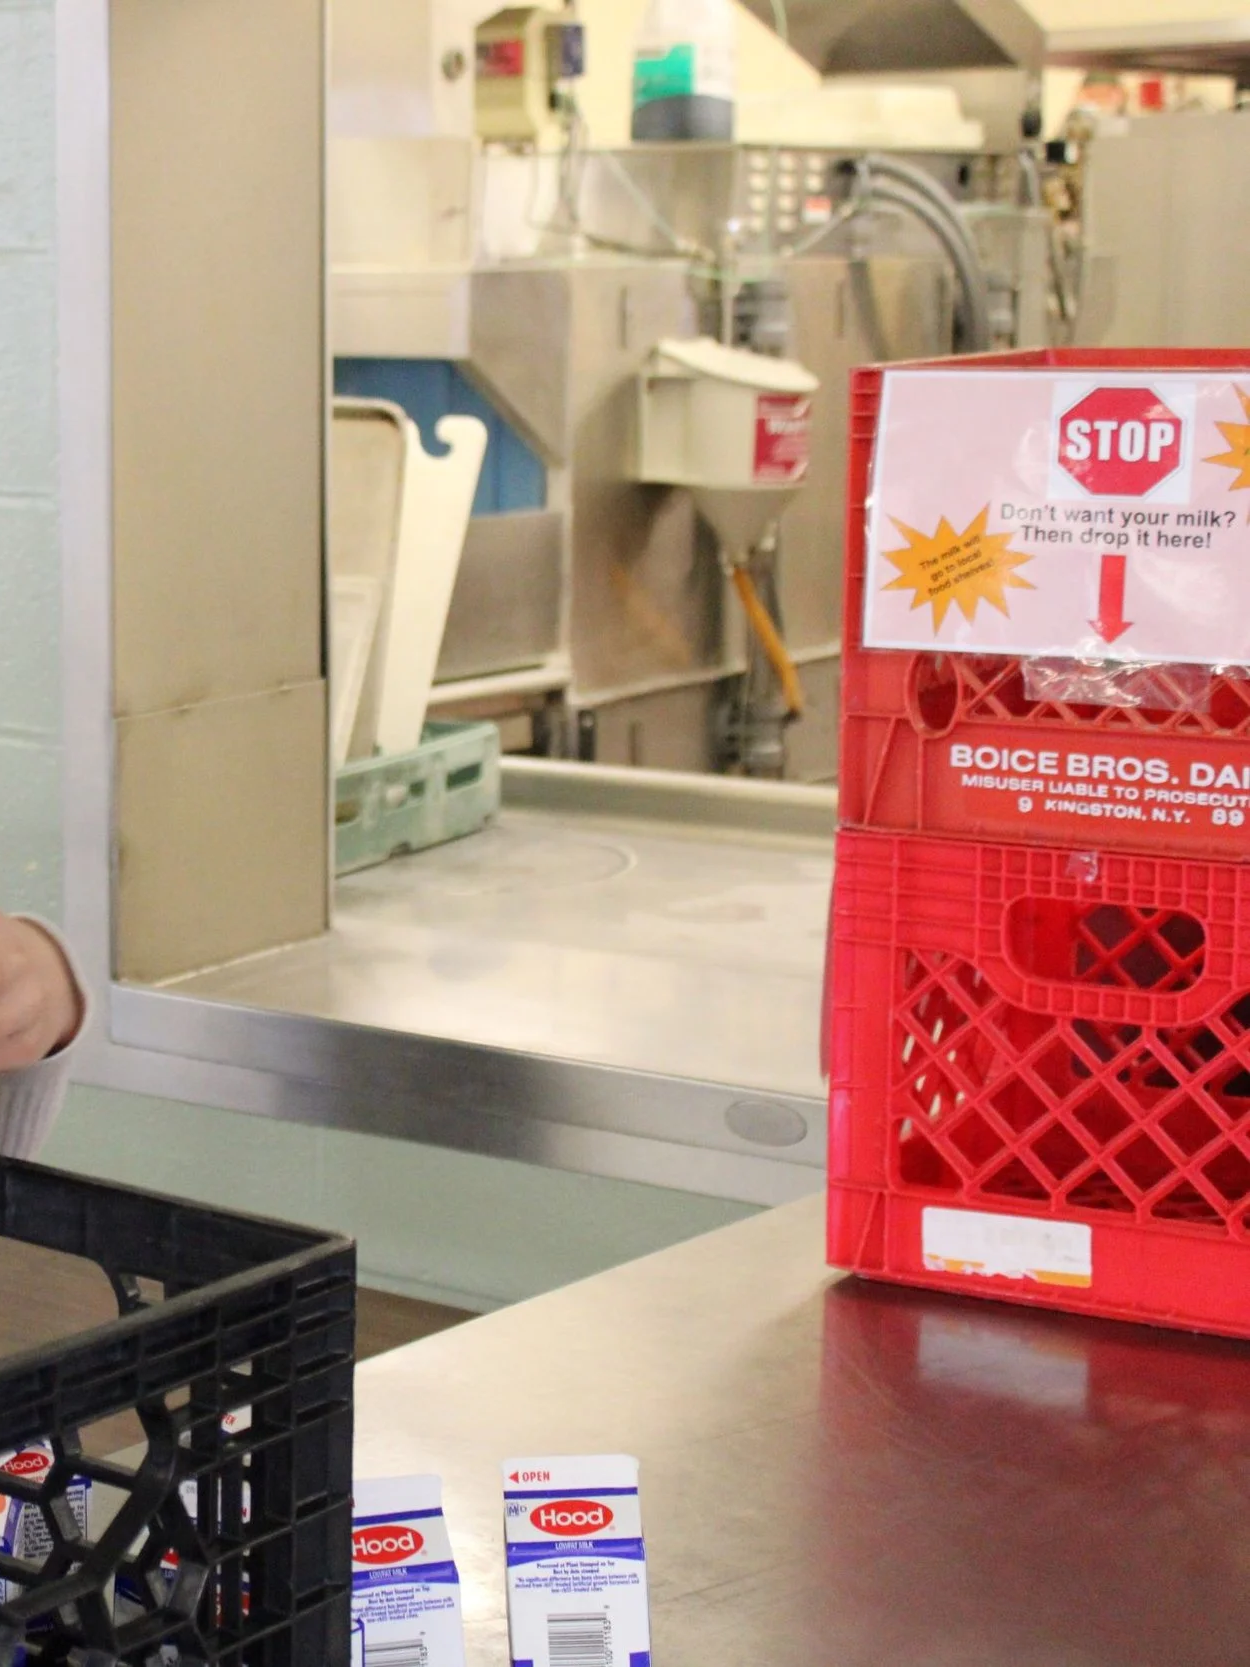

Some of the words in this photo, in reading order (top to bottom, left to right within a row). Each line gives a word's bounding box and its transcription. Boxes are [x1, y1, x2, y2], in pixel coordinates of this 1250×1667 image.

[1066, 418, 1175, 462] STOP
[1000, 503, 1057, 522] Don't
[1064, 507, 1114, 525] want
[1121, 512, 1169, 529] your
[1176, 510, 1237, 528] milk?
[1020, 525, 1073, 544] Then
[1080, 526, 1130, 548] drop
[1137, 529, 1150, 546] it
[1152, 532, 1212, 549] here!
[950, 744, 1059, 775] BOICE
[1067, 753, 1179, 785] BROS.
[961, 773, 1044, 793] MISUSER
[1048, 781, 1108, 799] LIABLE
[1113, 786, 1139, 800] TO
[1144, 788, 1250, 808] PROSECUT
[1044, 799, 1147, 821] KINGSTON,
[1152, 807, 1191, 824] N.Y.
[522, 1471, 550, 1482] OPEN
[540, 1507, 604, 1527] Hood
[352, 1532, 414, 1557] Hood
